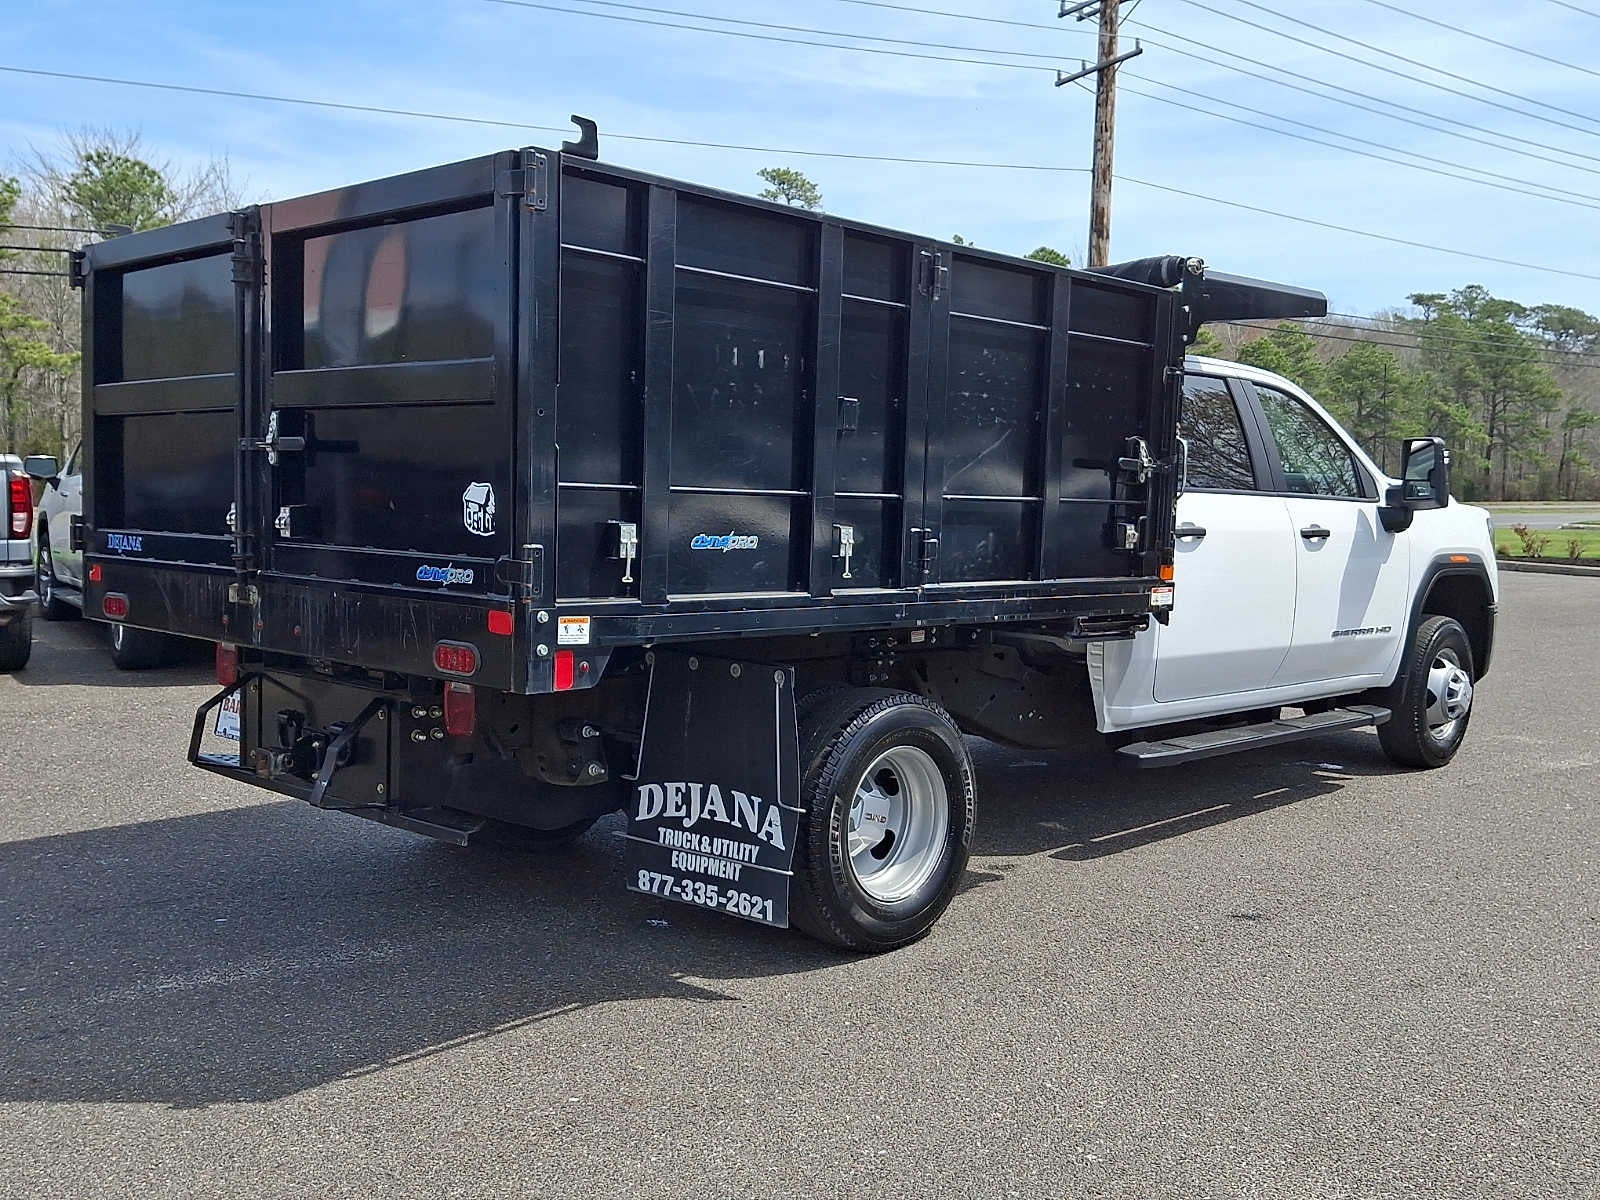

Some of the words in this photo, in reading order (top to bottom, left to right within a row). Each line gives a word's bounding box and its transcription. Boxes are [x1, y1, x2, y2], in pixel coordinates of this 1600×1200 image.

[106, 533, 142, 553] DEJANA
[1331, 627, 1374, 638] SIERRA
[1375, 626, 1392, 634] HD
[635, 782, 785, 850] DEJANA
[658, 827, 701, 851] TRUCK
[700, 835, 712, 853] &
[712, 837, 760, 864] UTILITY
[671, 850, 742, 882] EQUIPMENT
[637, 869, 773, 921] 877-335-2621
